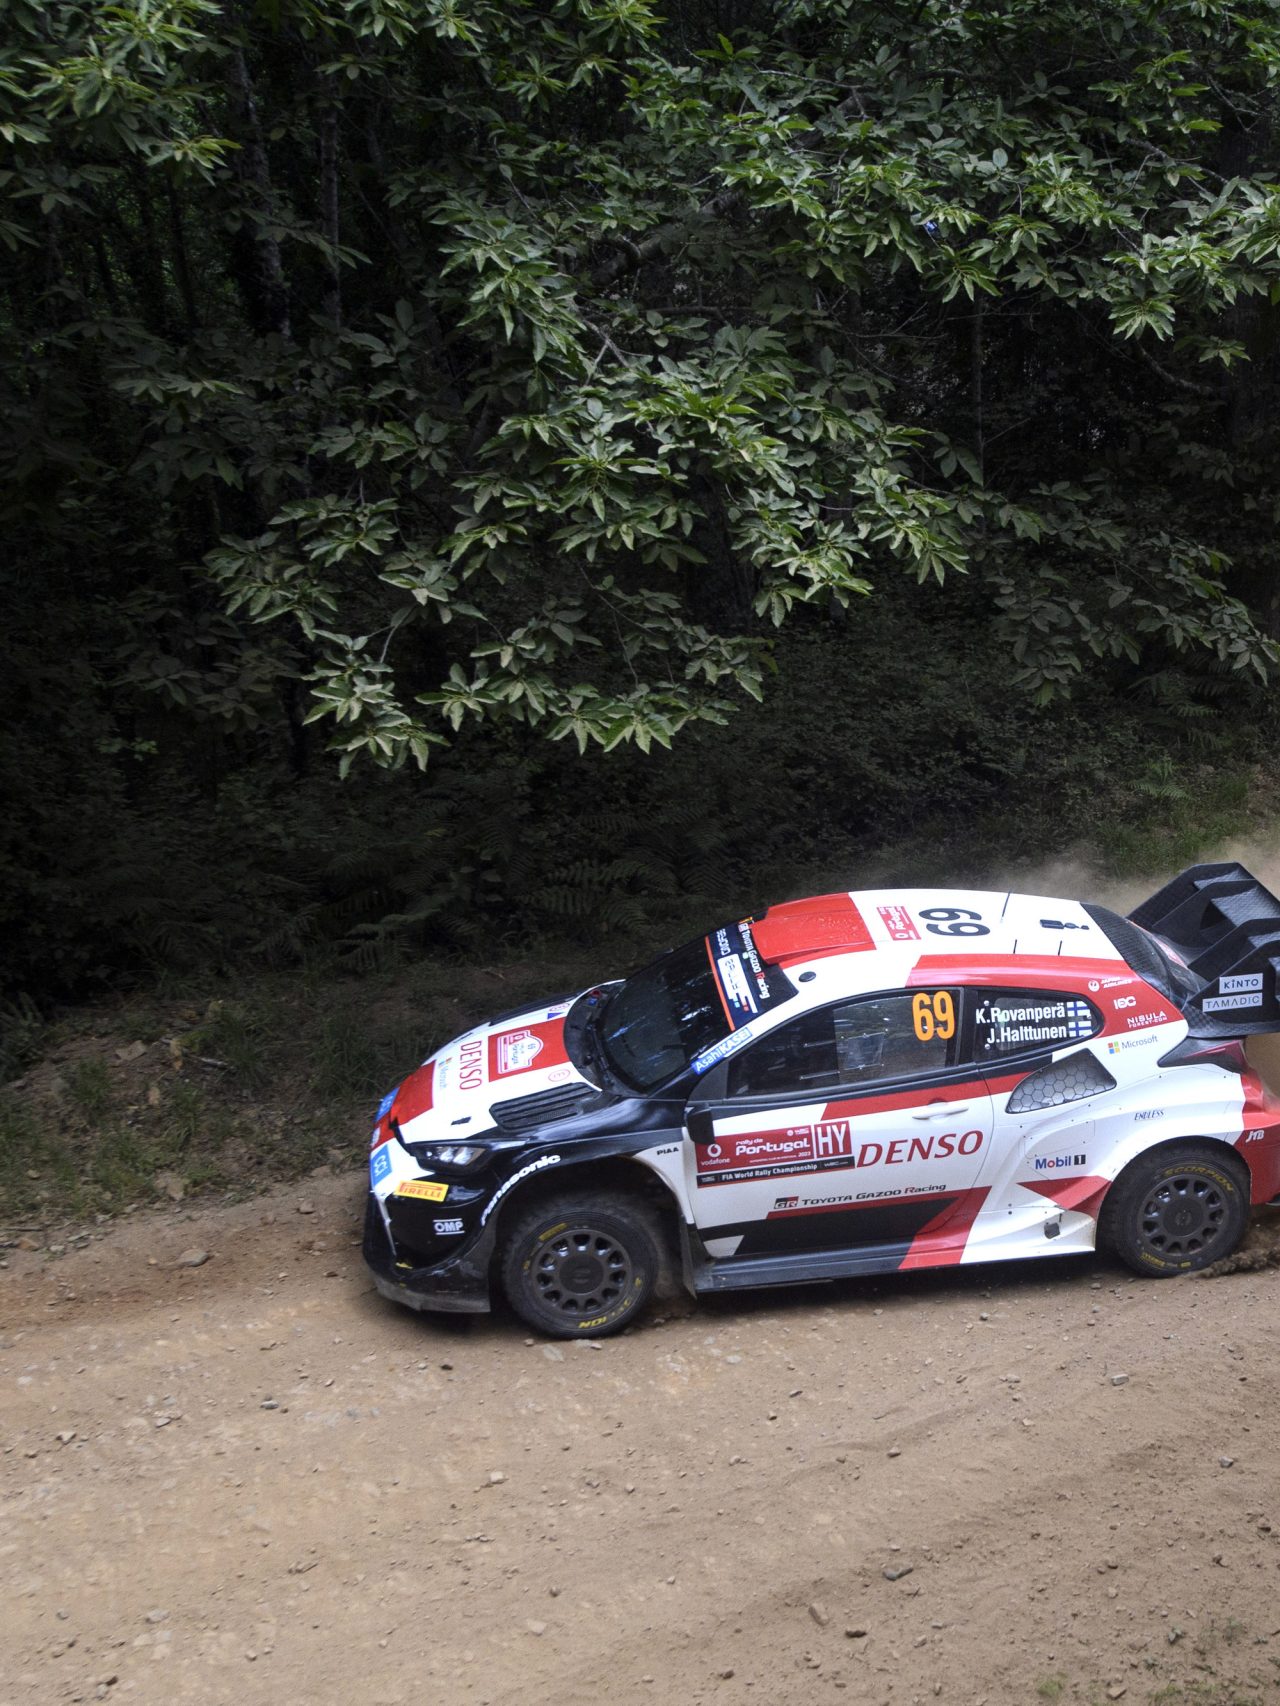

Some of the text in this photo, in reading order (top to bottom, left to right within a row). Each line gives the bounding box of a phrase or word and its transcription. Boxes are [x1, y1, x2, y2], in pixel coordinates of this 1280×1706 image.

[918, 907, 990, 937] 69
[755, 972, 770, 999] Racing
[1206, 996, 1260, 1009] TAMADIC
[912, 990, 955, 1042] 69
[975, 1002, 1065, 1025] K.Rovanperä
[1127, 1010, 1167, 1025] NISULA
[986, 1025, 1067, 1044] J.Halttunen
[1121, 1034, 1158, 1050] Microsoft
[459, 1040, 482, 1090] DENSO
[1134, 1109, 1164, 1121] ENDLESS
[816, 1123, 846, 1155] HY
[1245, 1129, 1265, 1143] JTB
[656, 1147, 679, 1156] PIAA
[735, 1138, 811, 1156] Portugal
[856, 1130, 984, 1168] DENSO
[701, 1157, 731, 1166] vodafone
[1035, 1155, 1072, 1170] Mobil
[734, 1171, 753, 1179] World
[755, 1169, 771, 1178] Rally
[772, 1163, 818, 1175] Championship
[1164, 1166, 1233, 1191] SCORPION
[400, 1182, 444, 1198] PIRELLI
[774, 1183, 947, 1209] GR TOYOTA GAZOO Racing
[434, 1220, 464, 1232] OMP
